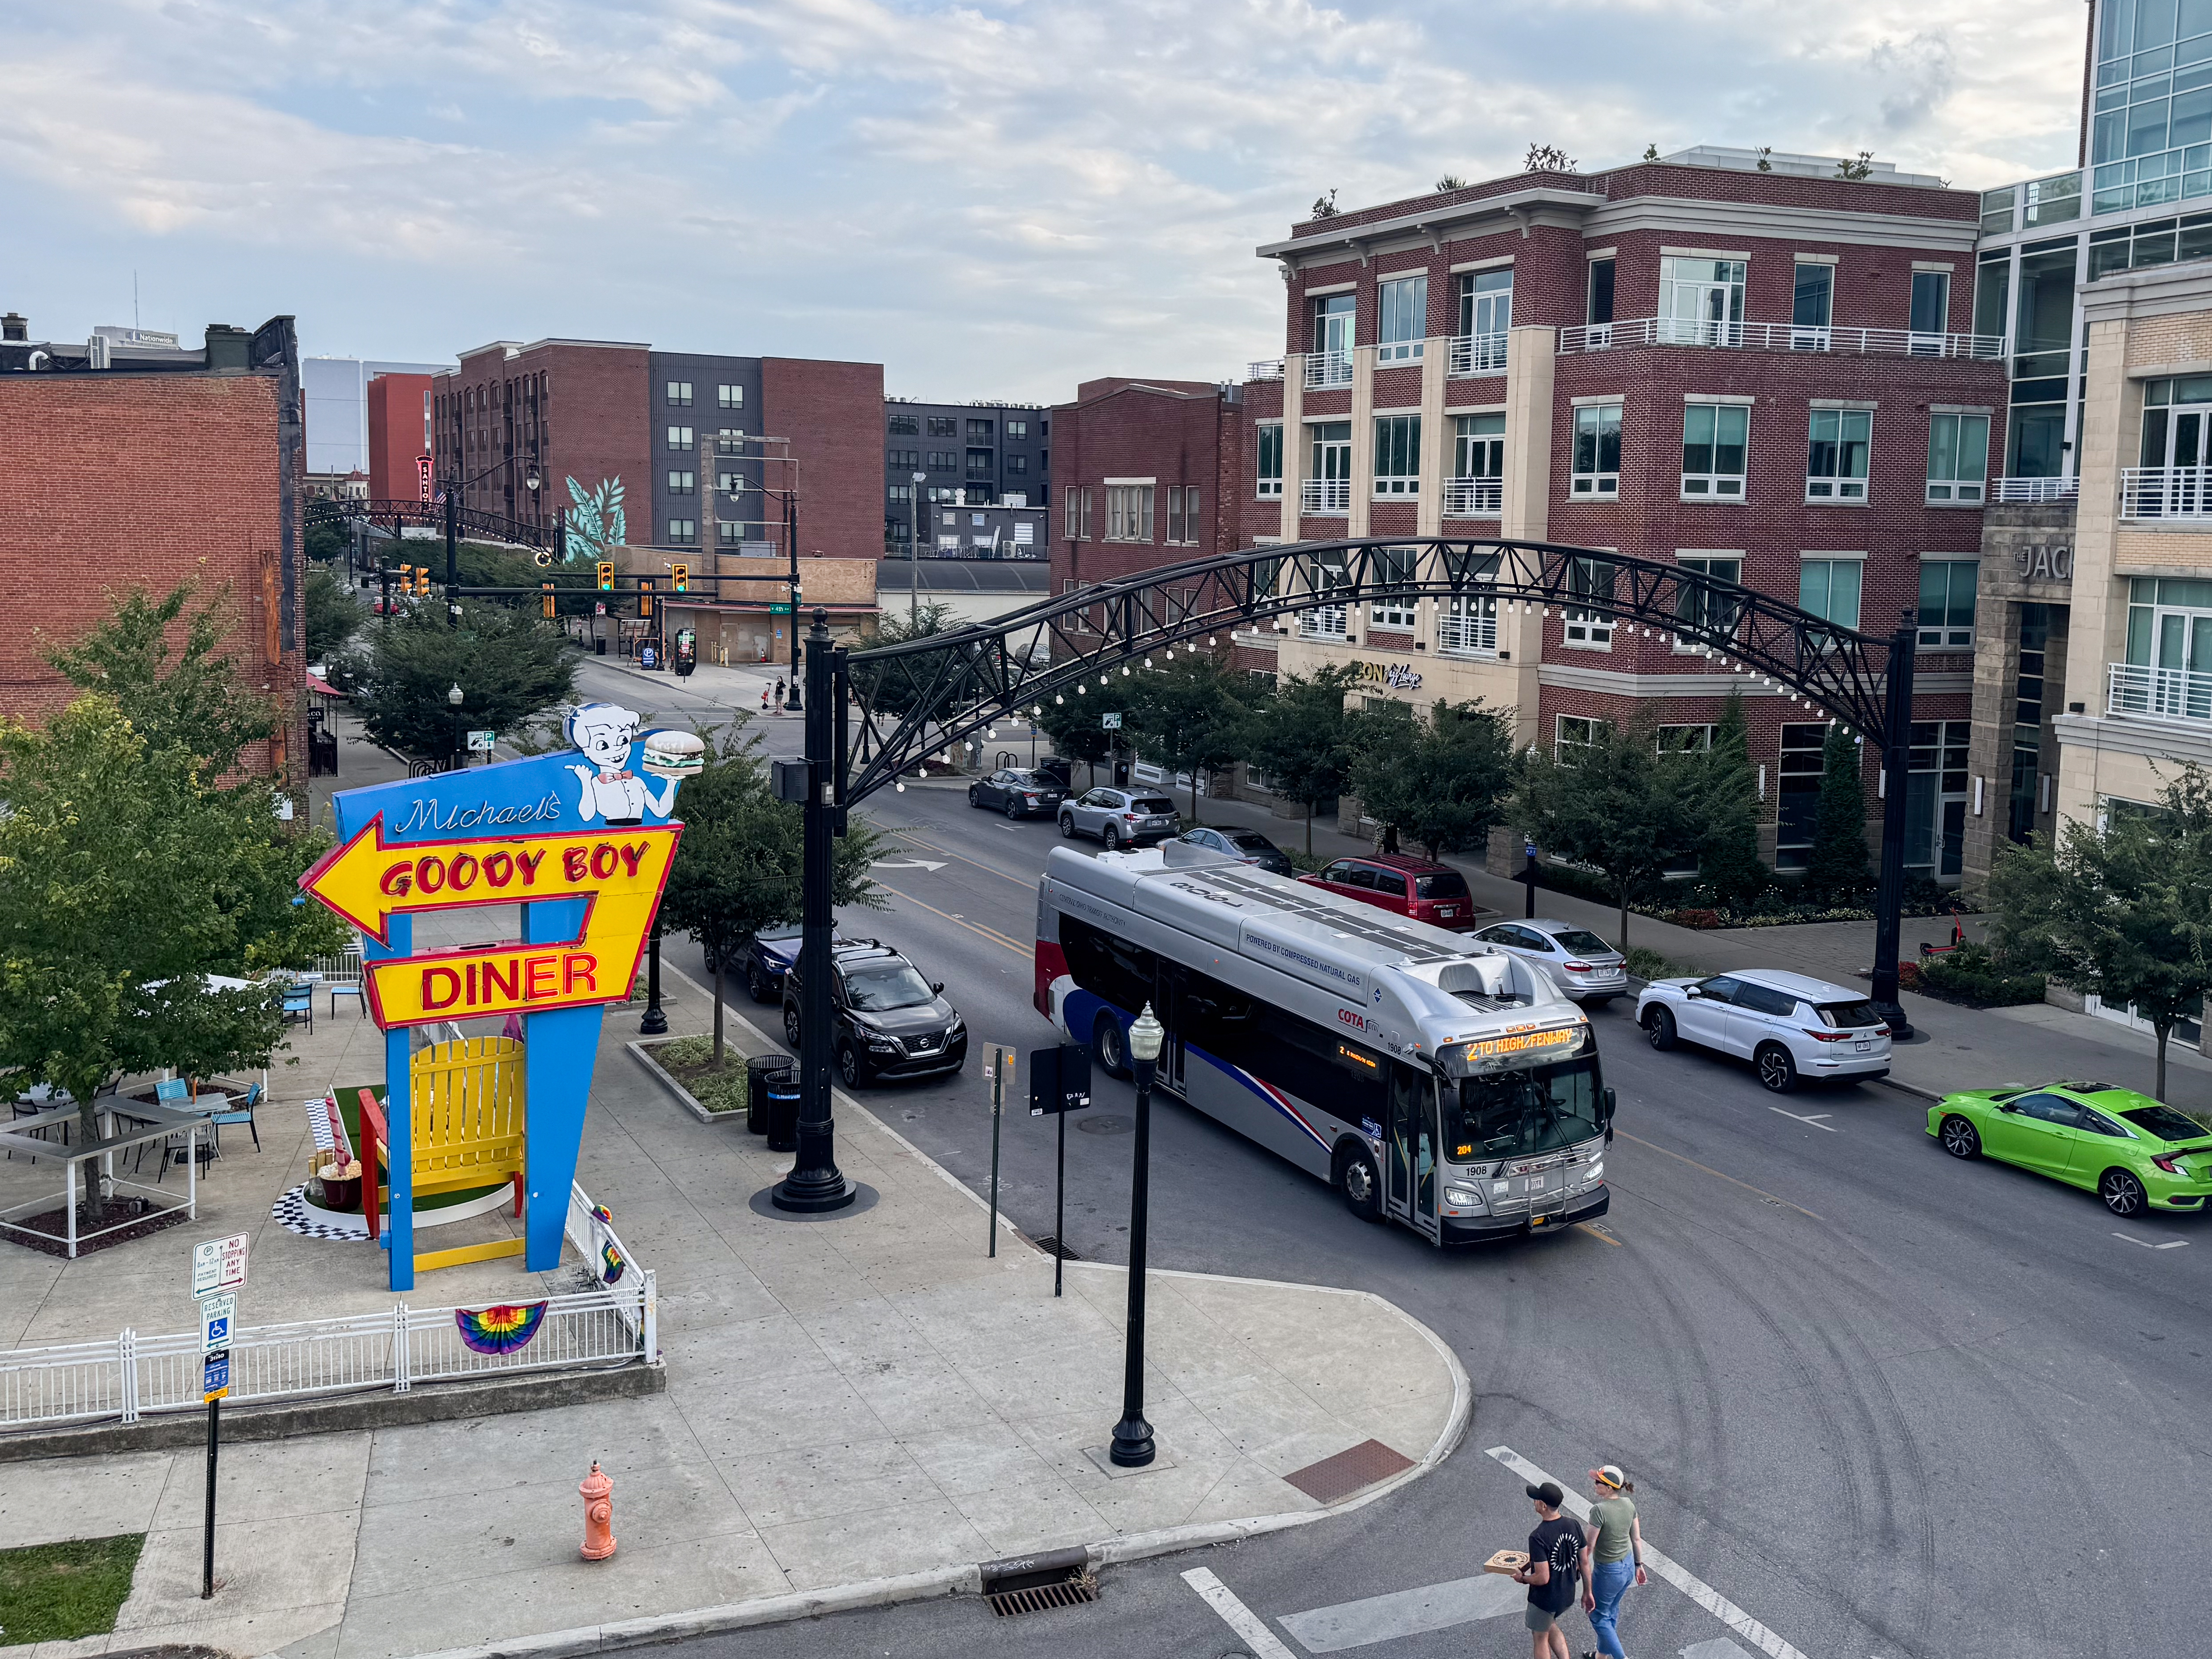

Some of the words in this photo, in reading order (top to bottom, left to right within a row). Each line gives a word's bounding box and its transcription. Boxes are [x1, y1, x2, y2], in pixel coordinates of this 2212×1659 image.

[140, 333, 173, 344] Nationwide
[2013, 552, 2026, 562] THE
[1354, 662, 1383, 682] ON
[380, 848, 547, 897] GOODY
[562, 841, 651, 882] BOY
[1246, 934, 1272, 950] POWERED
[1273, 944, 1281, 953] BY
[1281, 947, 1318, 969] COMPRESSED
[1319, 963, 1346, 980] NATURAL
[1347, 974, 1360, 986] GAS
[421, 952, 598, 1010] DINER
[1338, 1008, 1364, 1029] COTA
[1387, 1042, 1402, 1055] 1908
[1467, 1043, 1478, 1061] 2
[1479, 1040, 1493, 1055] TO
[1496, 1028, 1573, 1053] HIGH/FENWAY
[1457, 1145, 1472, 1155] 204
[1466, 1166, 1487, 1177] 1908
[229, 1238, 239, 1249] NO
[222, 1247, 245, 1261] STOPPING
[226, 1258, 240, 1268] ANY
[225, 1267, 240, 1276] TIME
[204, 1297, 233, 1312] RESERVED
[206, 1307, 231, 1320] PARKING
